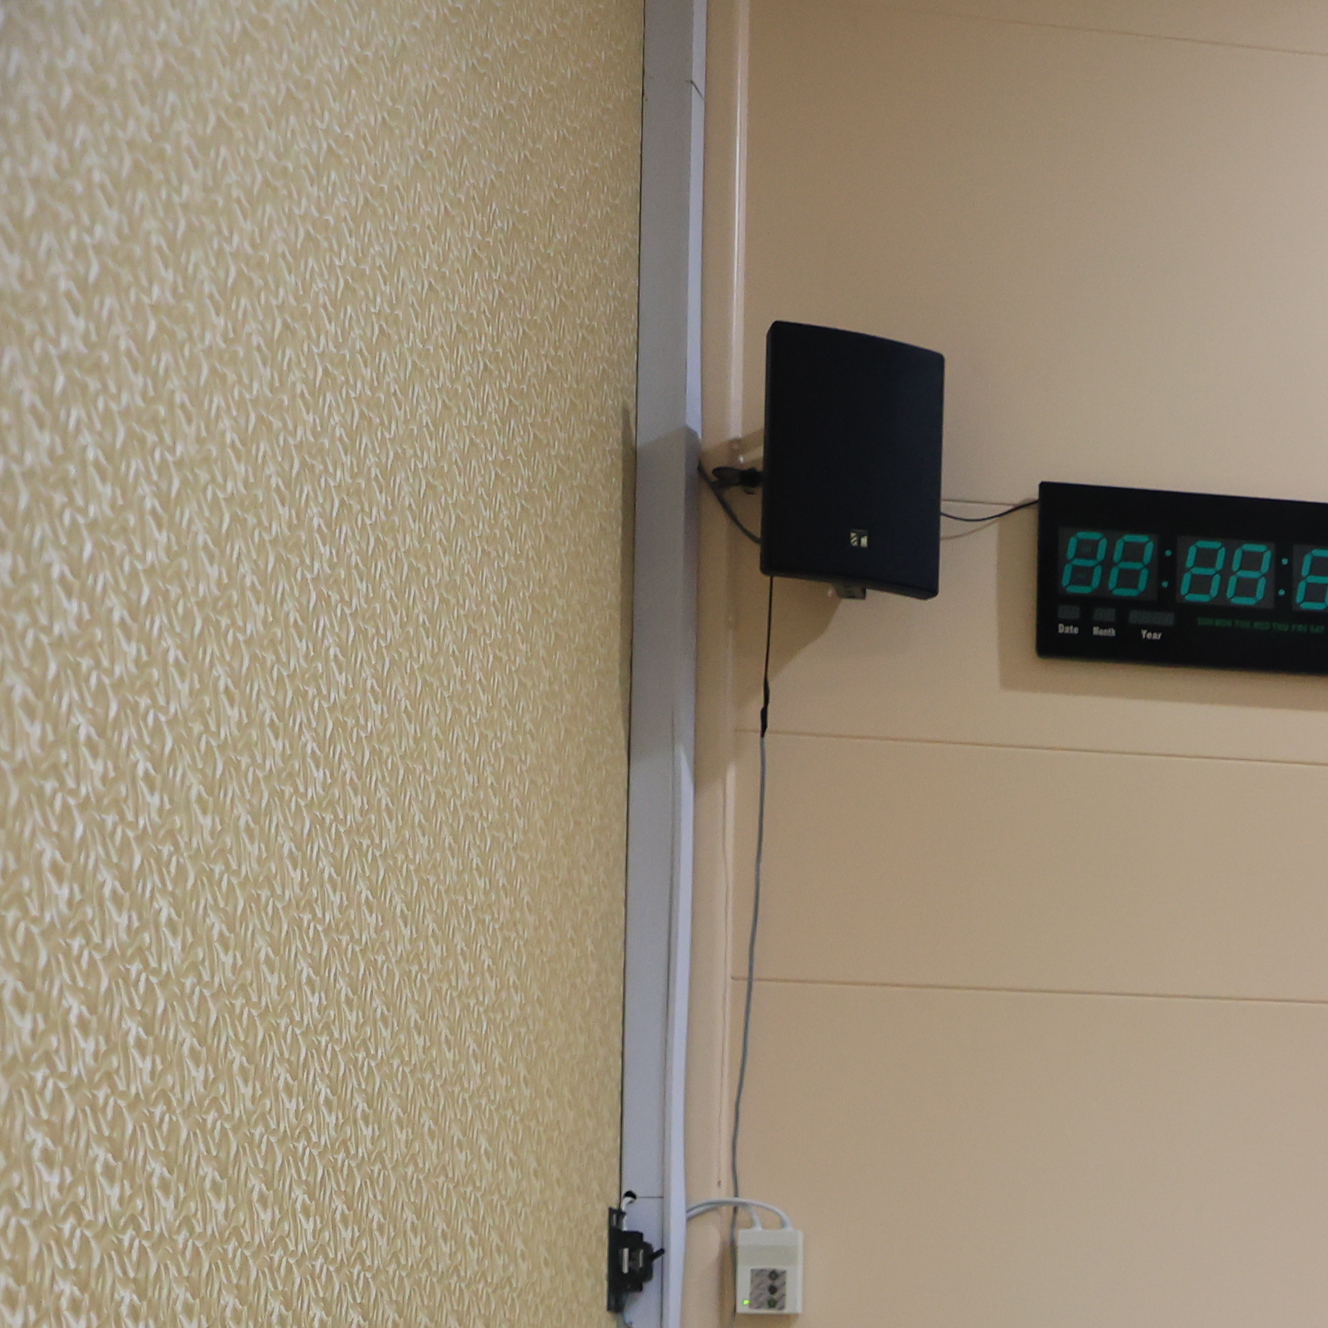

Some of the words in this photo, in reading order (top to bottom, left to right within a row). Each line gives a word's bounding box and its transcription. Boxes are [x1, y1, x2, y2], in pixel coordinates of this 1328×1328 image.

[1058, 623, 1079, 635] Date
[1092, 626, 1116, 637] Month
[1141, 629, 1162, 640] Year
